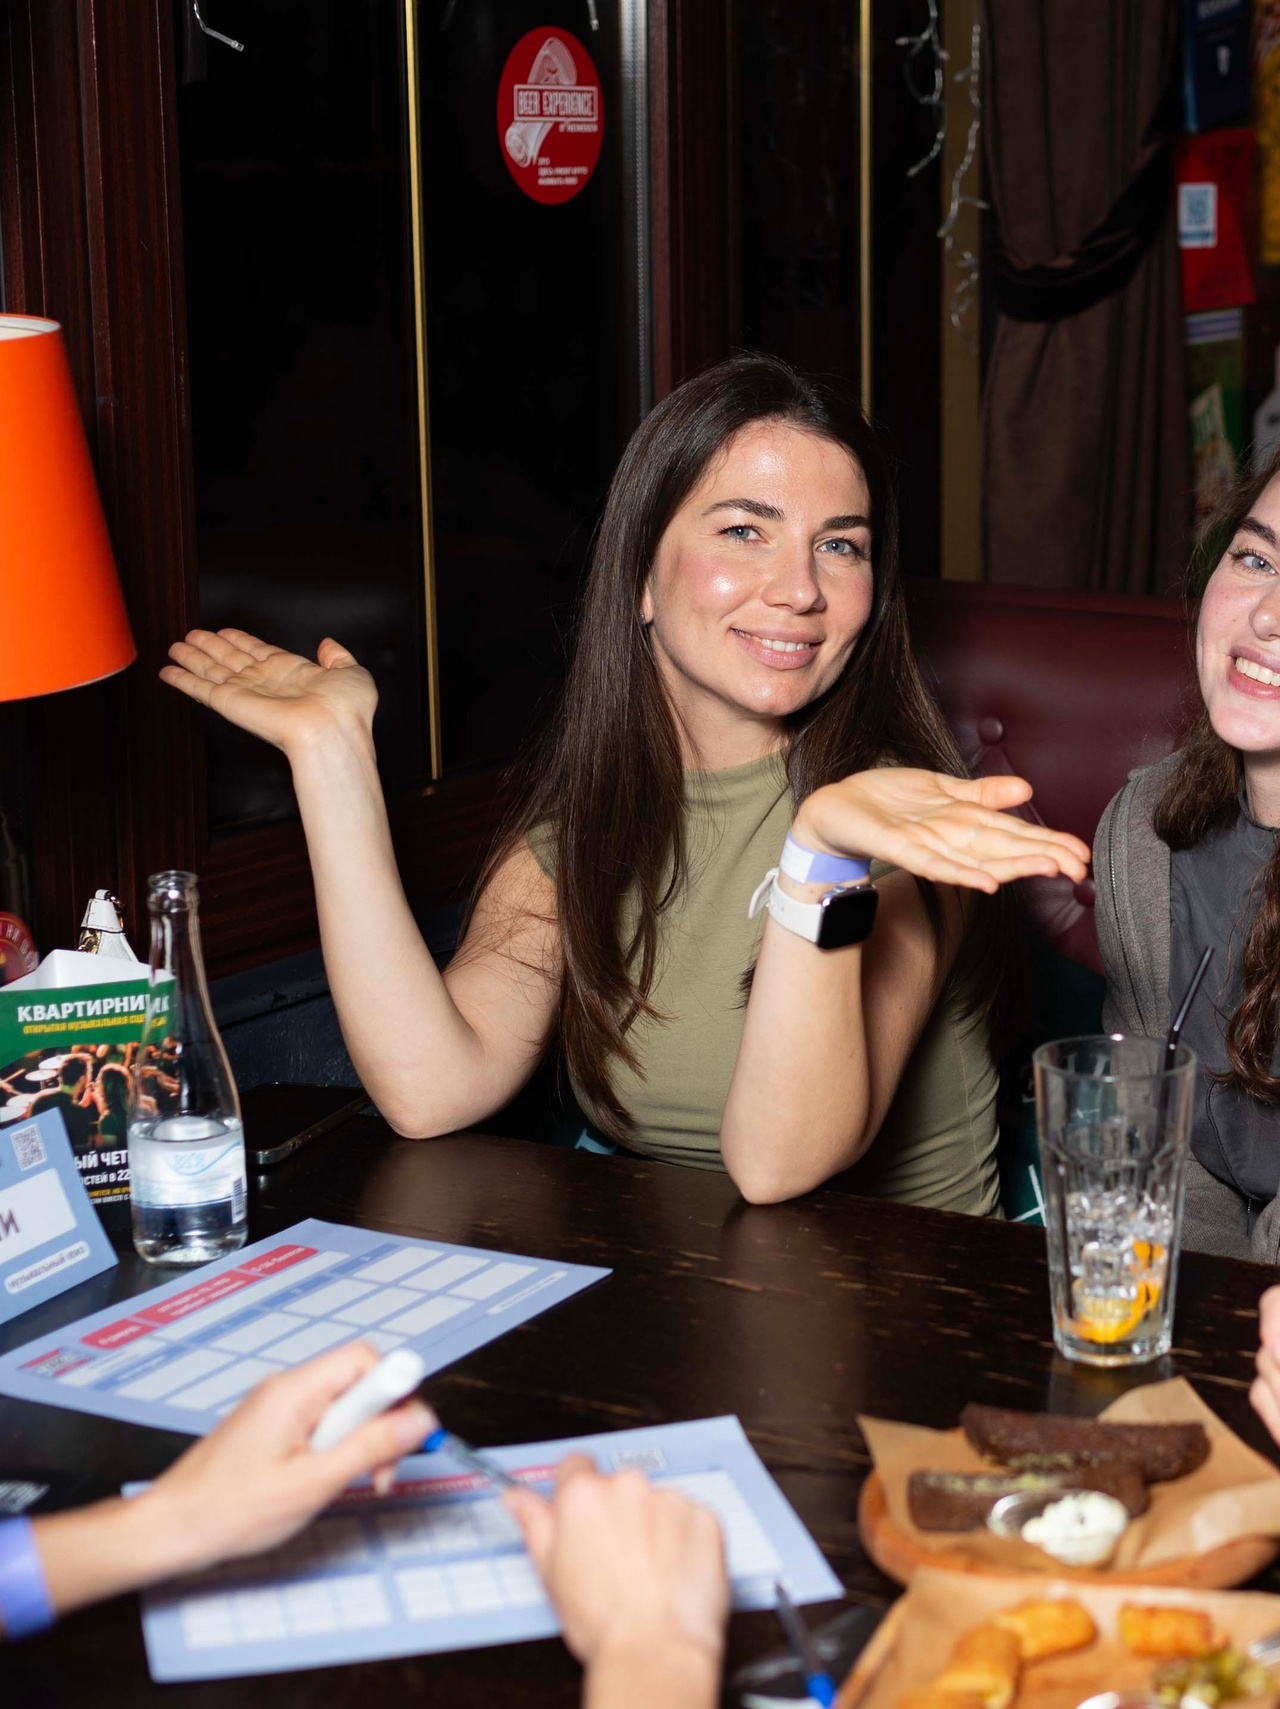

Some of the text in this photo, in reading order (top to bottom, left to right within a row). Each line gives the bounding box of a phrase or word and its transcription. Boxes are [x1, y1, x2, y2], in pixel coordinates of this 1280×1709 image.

[519, 91, 593, 116] BEER EXPERIENCE
[23, 1023, 66, 1035] ОТКРЫТАЯ
[67, 1015, 128, 1032] МУЗЫКАЛЬНАЯ
